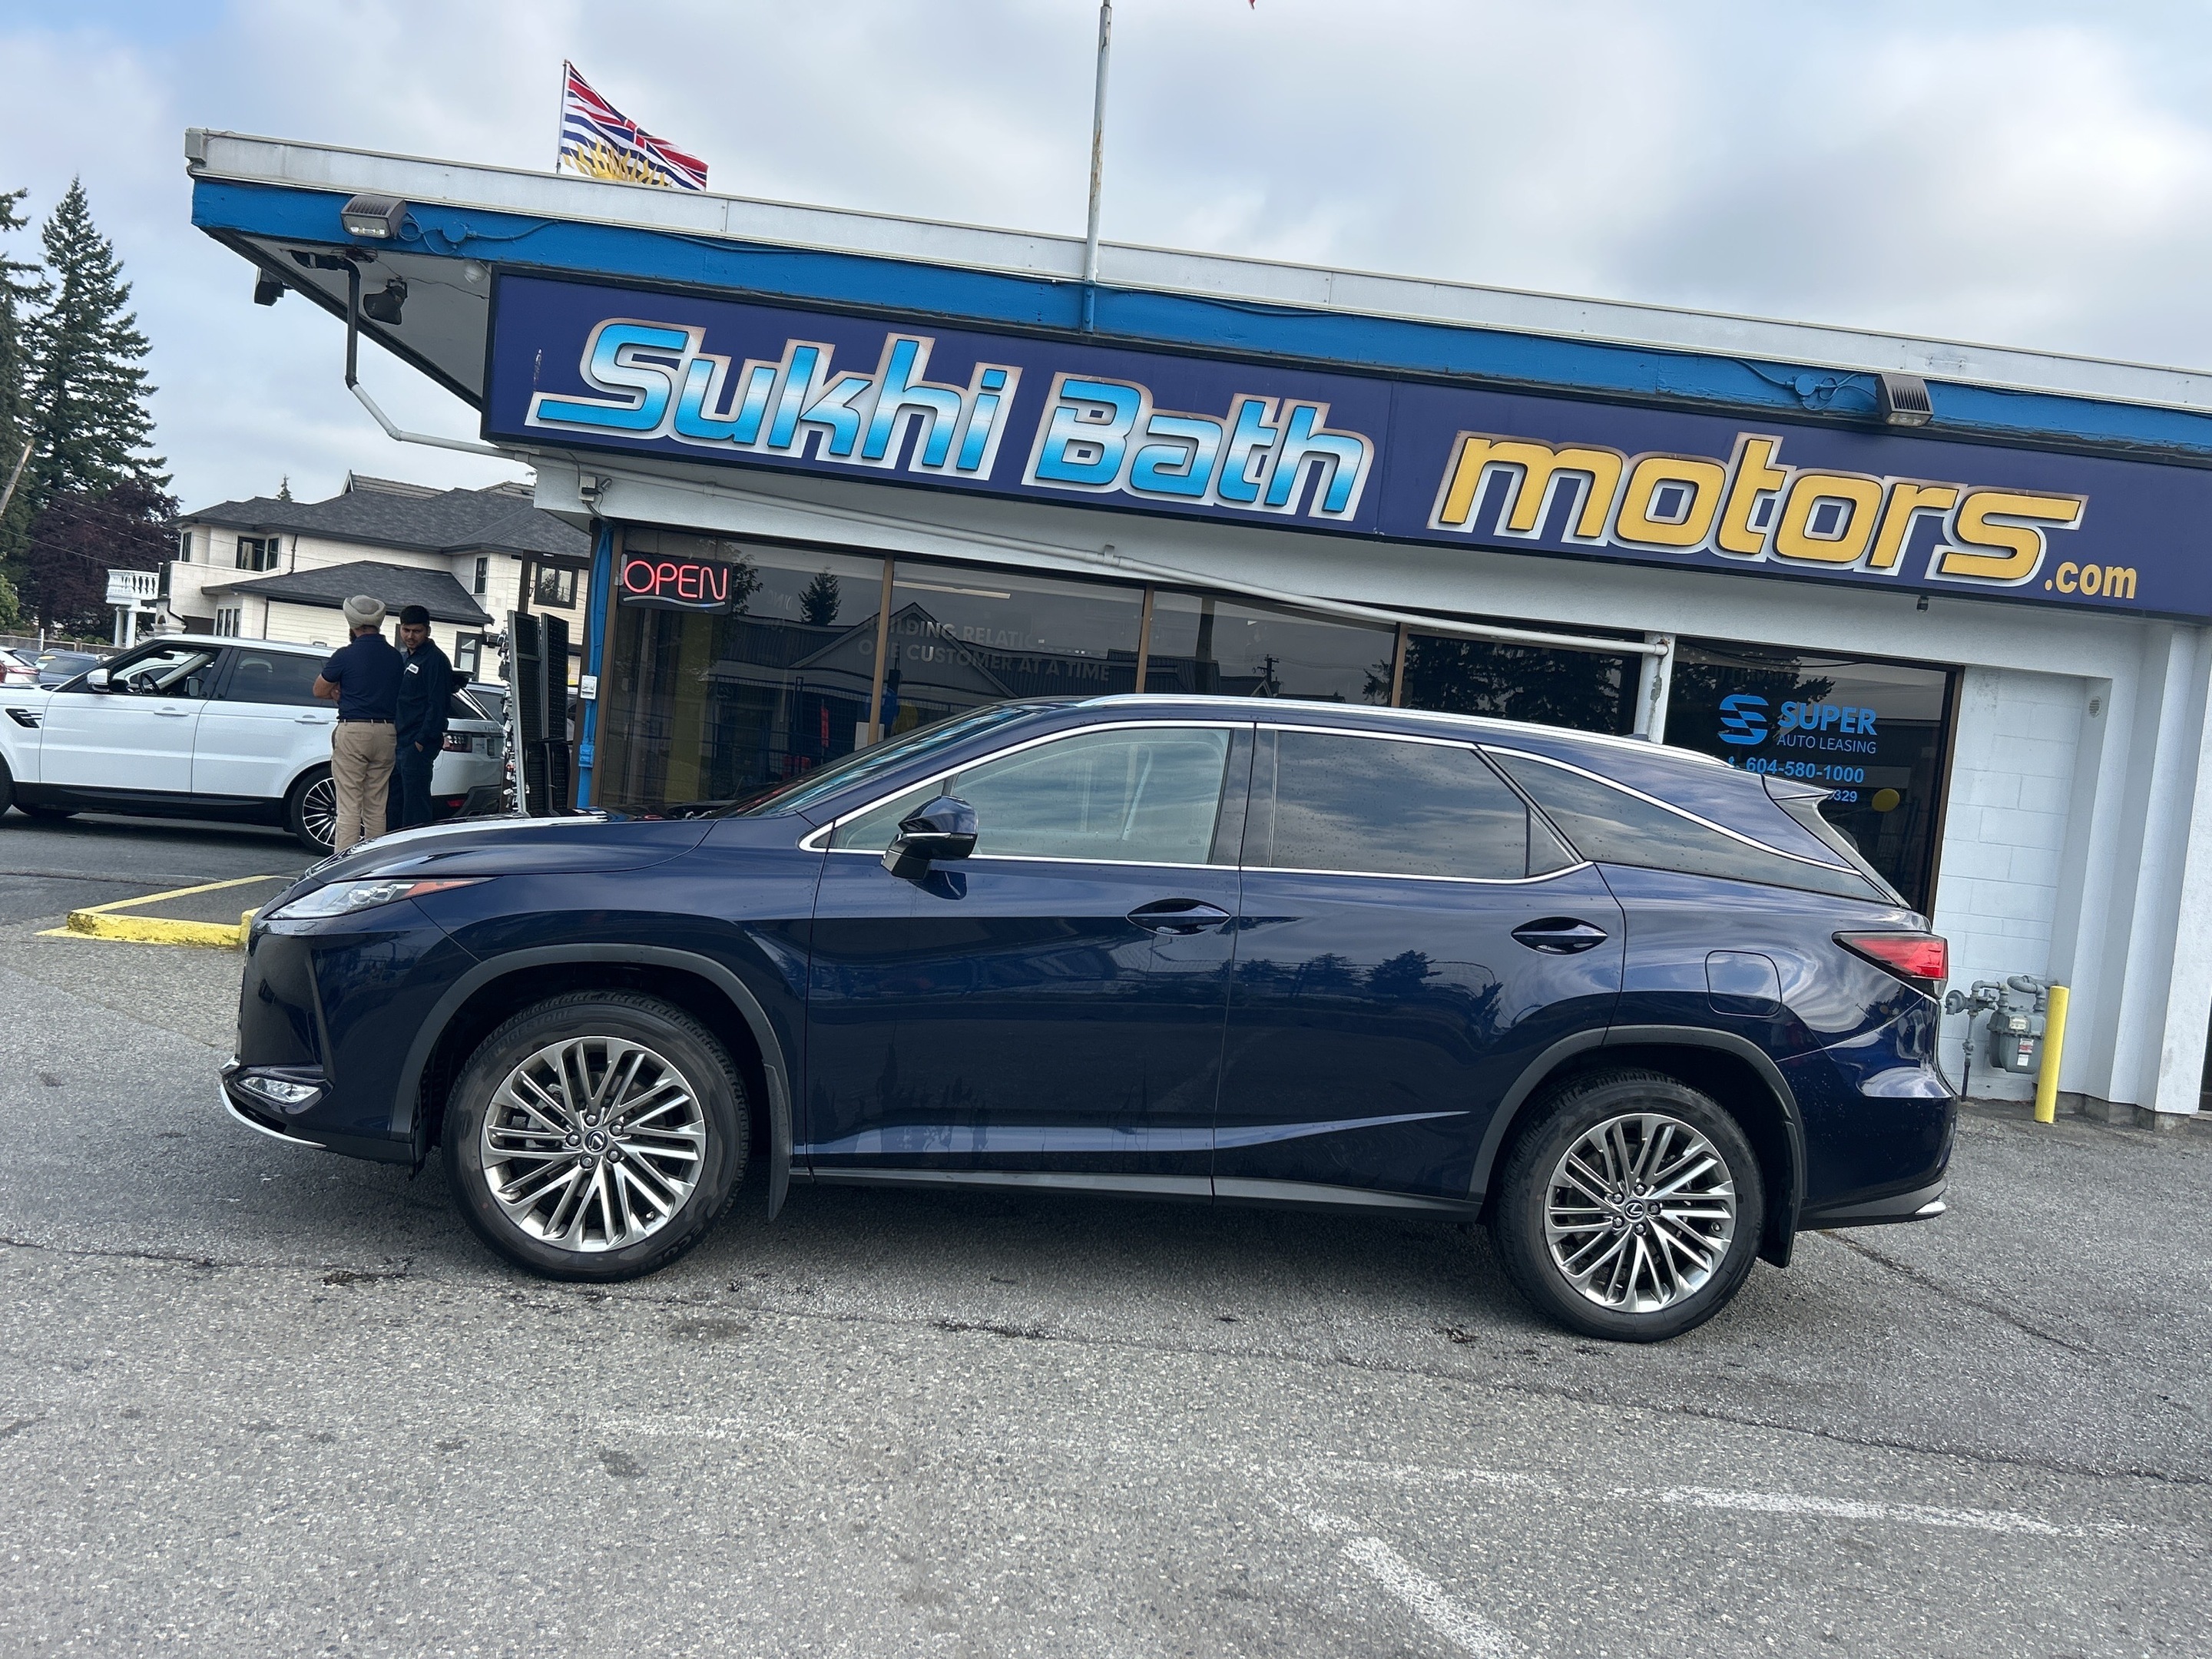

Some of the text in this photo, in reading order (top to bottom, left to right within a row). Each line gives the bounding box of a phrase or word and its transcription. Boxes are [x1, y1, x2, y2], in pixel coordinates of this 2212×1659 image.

[525, 318, 2137, 599] Sukhi Bath motors .com
[624, 560, 727, 601] OPEN
[906, 644, 1012, 671] CUSTOMER
[1018, 657, 1043, 674] AT
[1046, 660, 1060, 675] A
[1066, 661, 1110, 681] TIME
[1777, 700, 1878, 736] SUPER
[1777, 734, 1877, 754] AUTO LEASING
[1746, 757, 1865, 783] 604-580-1000
